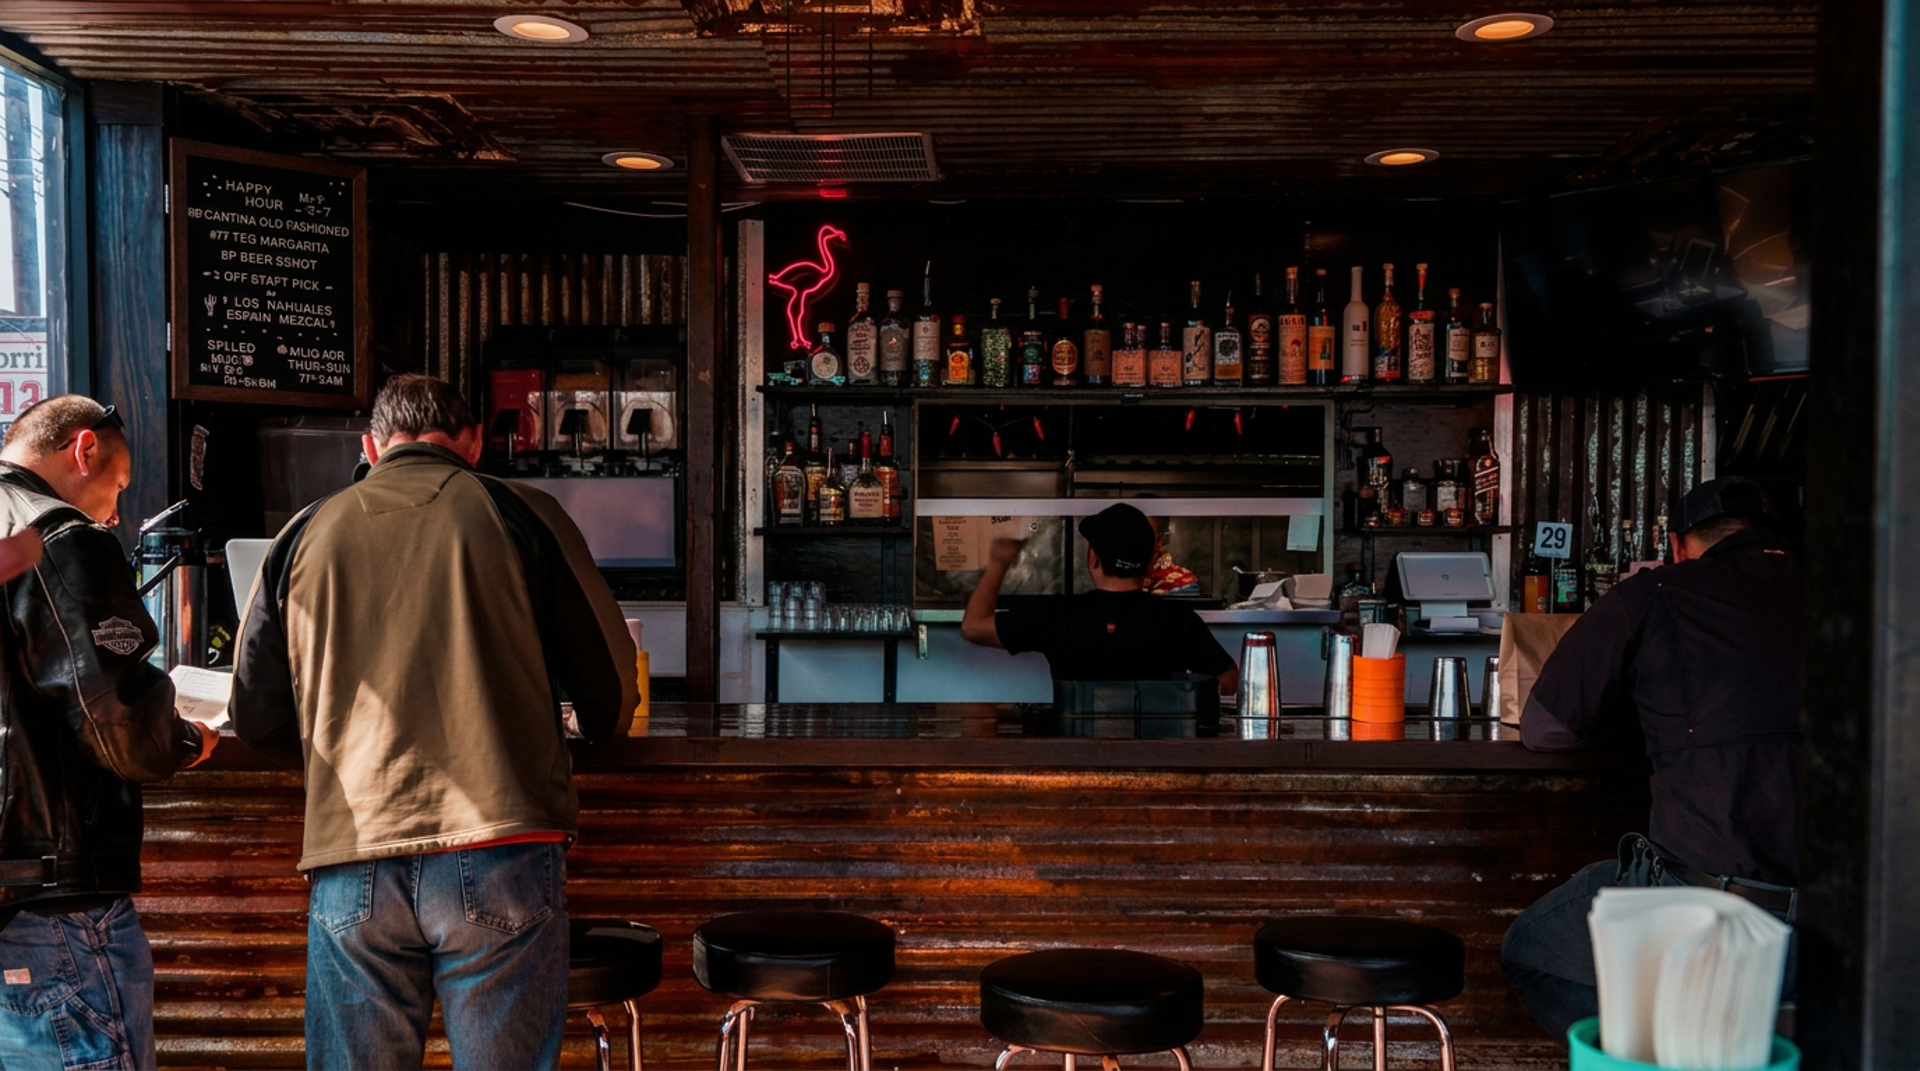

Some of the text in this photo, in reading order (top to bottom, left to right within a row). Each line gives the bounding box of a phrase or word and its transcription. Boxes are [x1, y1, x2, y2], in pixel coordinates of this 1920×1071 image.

[225, 180, 272, 195] HAPPY
[245, 196, 284, 210] HOUR
[204, 210, 256, 226] CANTINA
[260, 236, 330, 254] MARGARITA
[240, 251, 273, 265] BEER
[224, 271, 248, 283] OFF
[292, 278, 320, 291] PICK
[267, 300, 333, 316] NAHUALES
[278, 314, 328, 329] MEZCAL
[1540, 526, 1566, 550] 29
